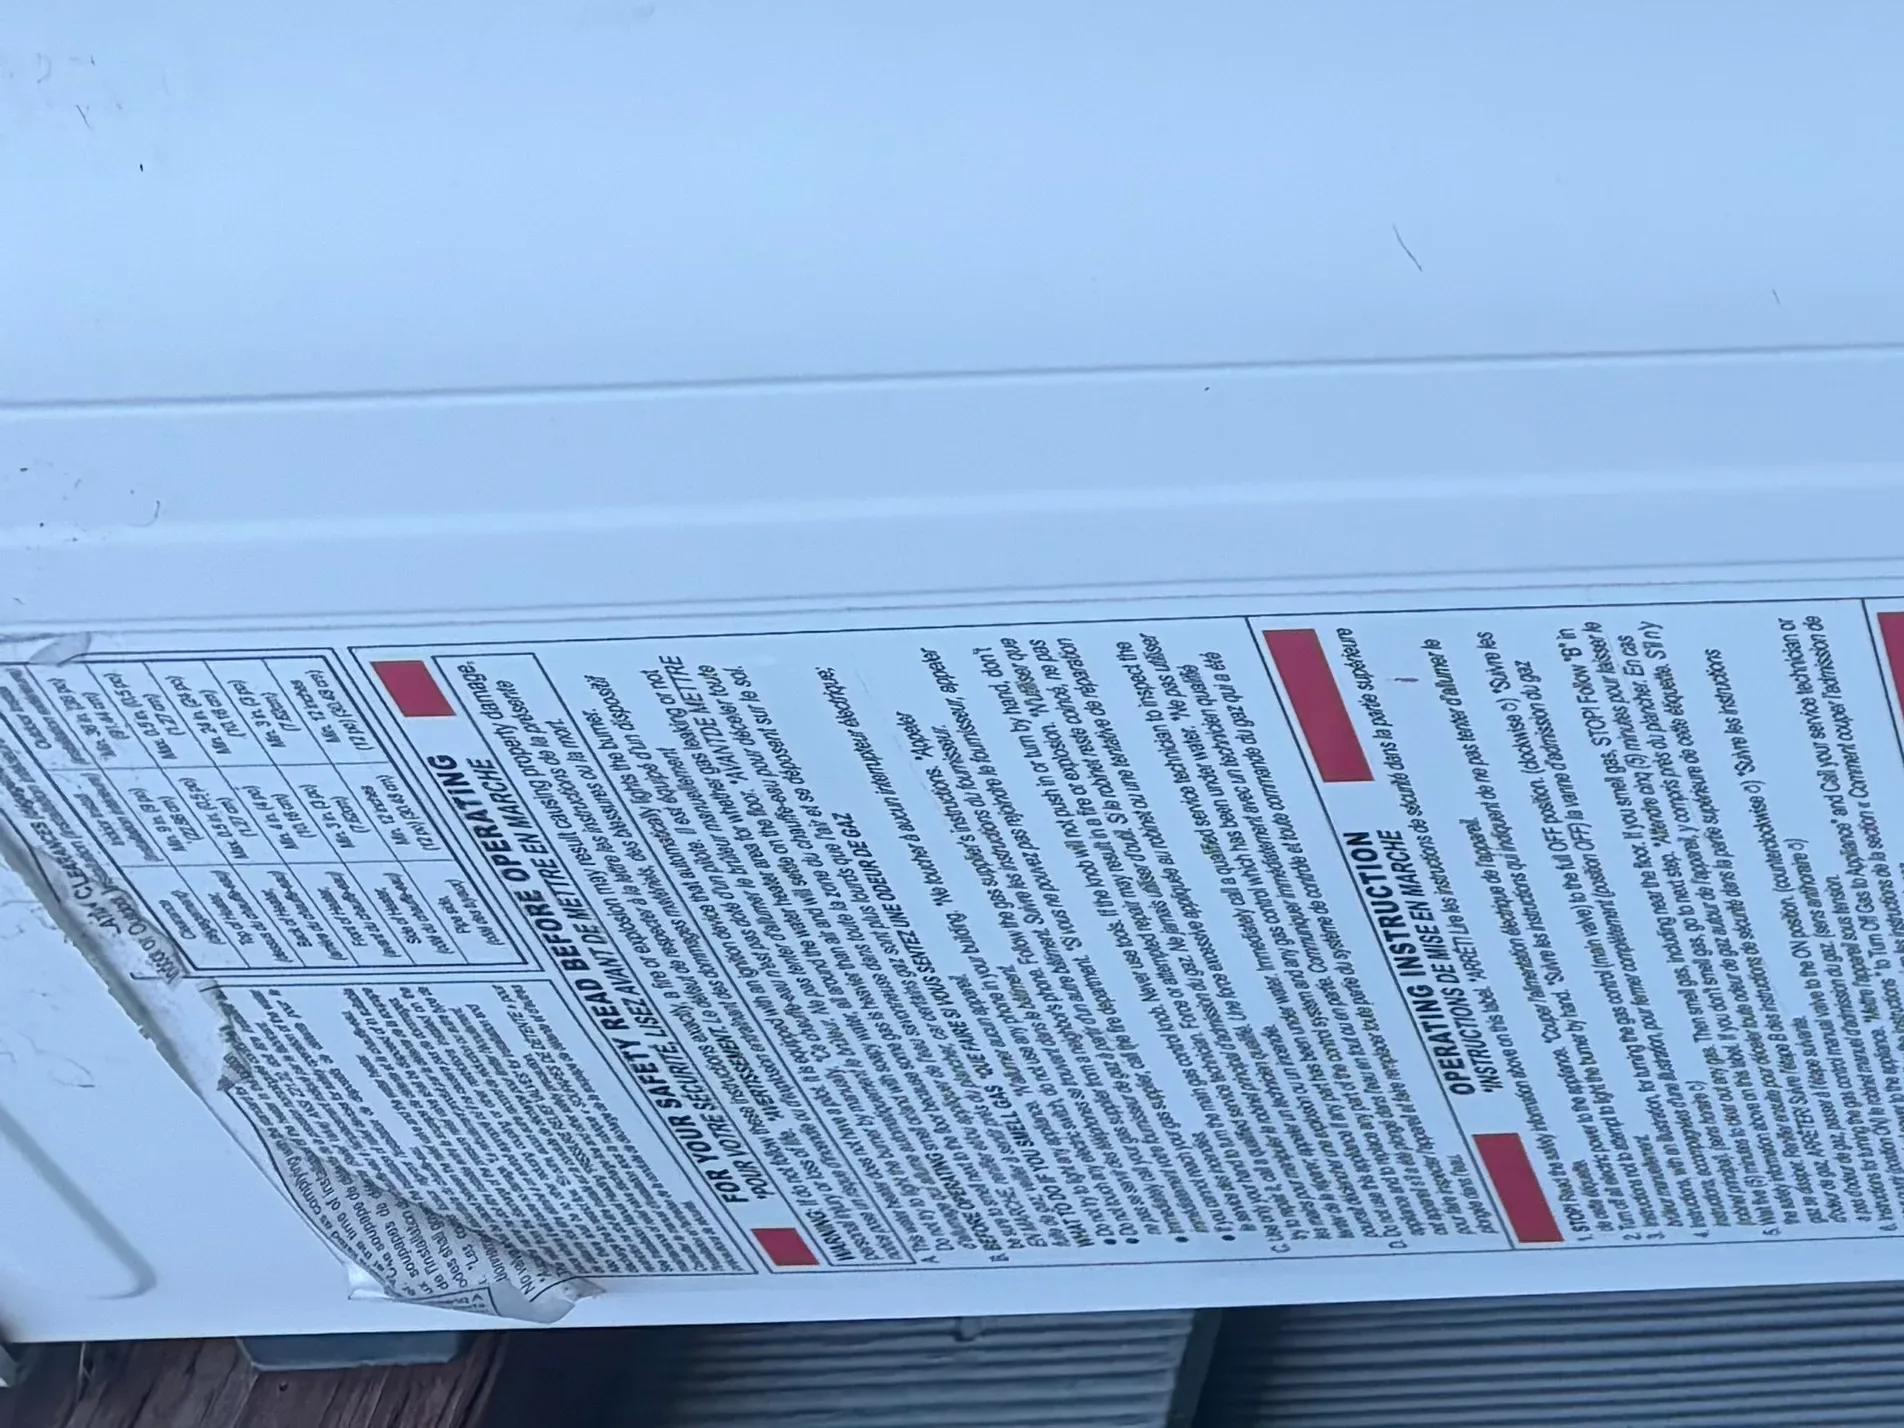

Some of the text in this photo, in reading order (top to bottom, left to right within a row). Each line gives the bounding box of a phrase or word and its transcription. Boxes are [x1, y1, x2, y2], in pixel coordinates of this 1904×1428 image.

[491, 721, 546, 777] property
[465, 757, 533, 829] MARCHE
[527, 779, 573, 829] causing
[830, 811, 862, 838] GAZ
[512, 831, 549, 854] EN
[556, 830, 596, 866] result
[846, 839, 873, 857] DE
[1375, 829, 1425, 897] MARCHE
[528, 857, 592, 920] METTRE
[582, 867, 616, 895] may
[857, 859, 896, 901] ODEUR
[601, 897, 651, 954] explosion
[880, 902, 910, 928] UNE
[1403, 899, 1435, 921] EN
[571, 922, 608, 945] DE
[1413, 923, 1451, 960] MISE
[638, 955, 661, 968] or
[895, 929, 936, 974] SENTEZ
[1341, 831, 1476, 1095] OPERATING INSTRUCTION
[425, 754, 749, 1203] FOR YOUR SAFETY READ BEFORE OPERATING
[586, 946, 641, 996] AVANT
[648, 969, 674, 989] fire
[1429, 962, 1460, 984] DE
[921, 975, 954, 1006] VOUS
[620, 996, 668, 1037] LISEZ
[939, 1007, 962, 1019] SI
[946, 1020, 981, 1052] FAIRE
[647, 1040, 718, 1111] SÉCURITÉ,
[696, 1044, 750, 1104] instructions
[982, 1084, 1012, 1109] GAS
[698, 1112, 748, 1157] VOTRE
[738, 1105, 770, 1135] these
[999, 1109, 1035, 1147] SMELL
[757, 1135, 791, 1166] follow
[1019, 1148, 1049, 1172] YOU
[775, 1166, 803, 1183] not
[789, 1183, 813, 1198] do
[1041, 1184, 1067, 1201] DO
[1050, 1201, 1076, 1217] TO
[804, 1207, 856, 1261] WARNING:
[1061, 1217, 1095, 1248] WHAT
